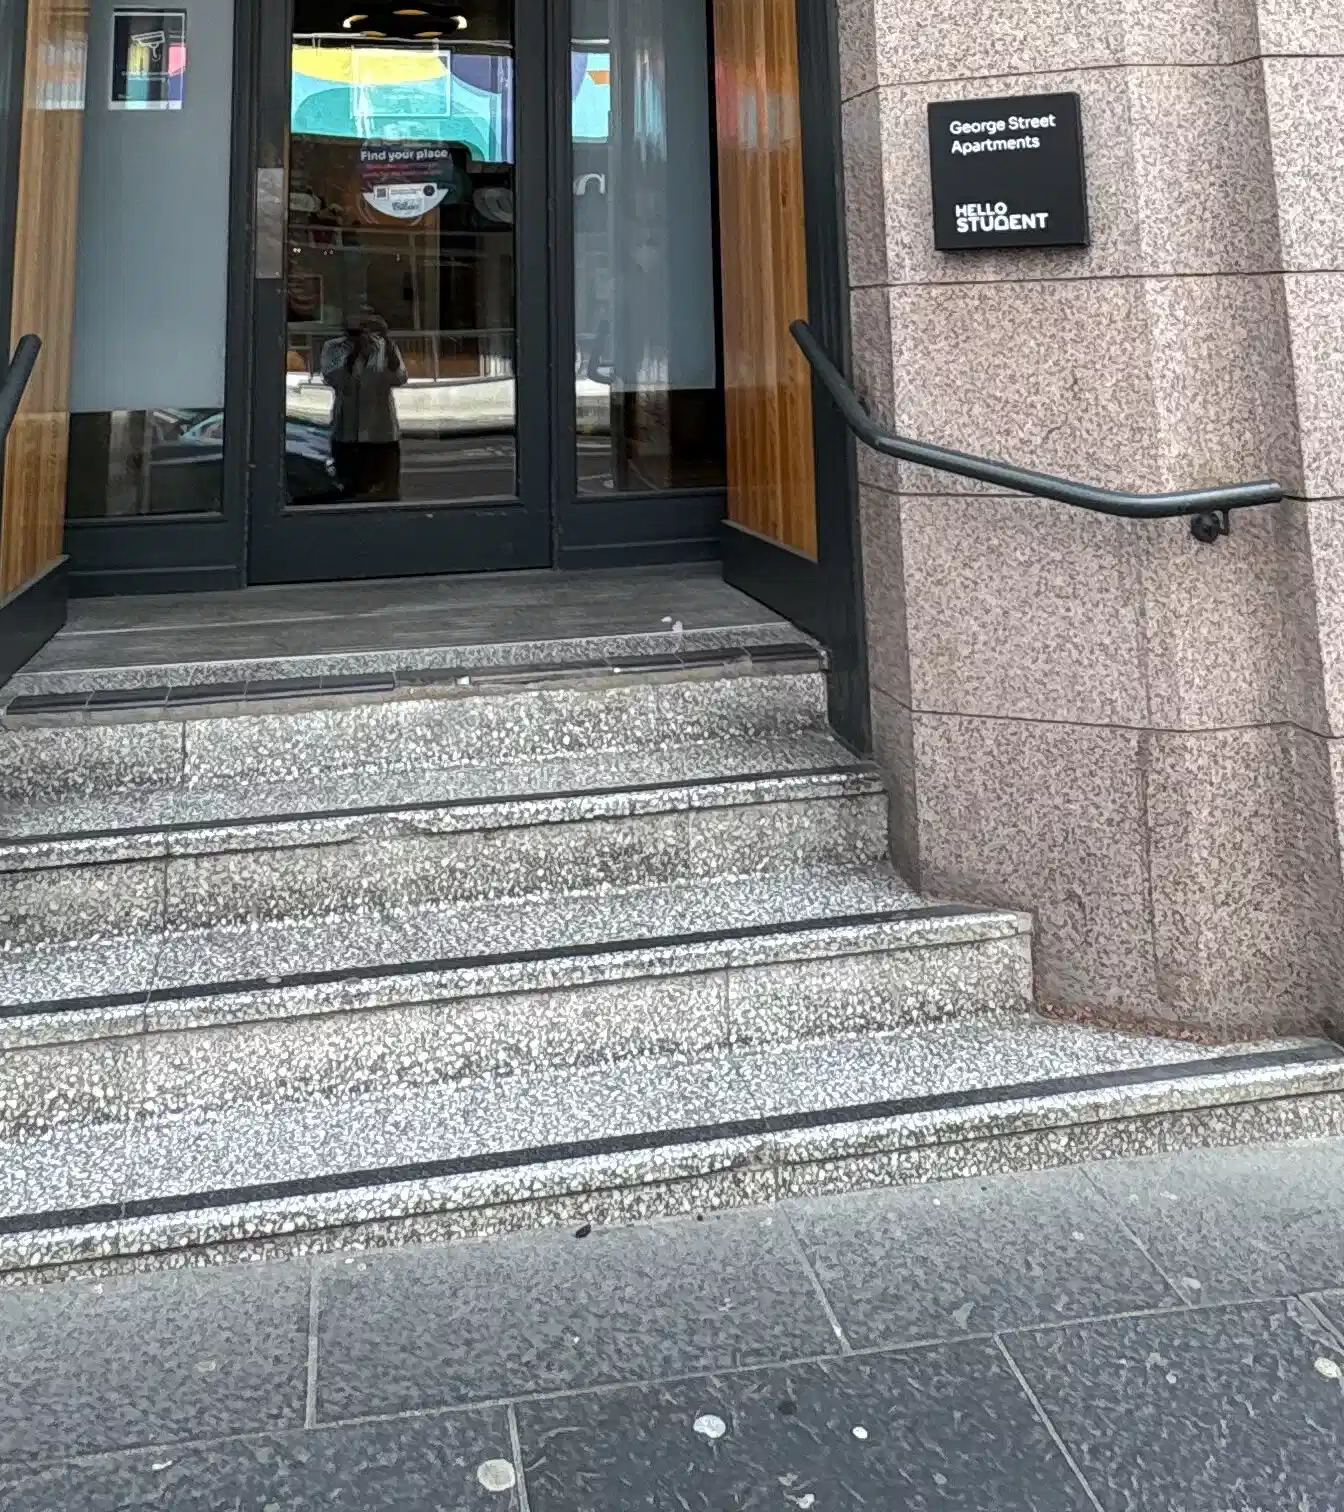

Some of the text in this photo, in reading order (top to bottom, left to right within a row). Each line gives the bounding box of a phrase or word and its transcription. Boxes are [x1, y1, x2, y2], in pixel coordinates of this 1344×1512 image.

[949, 114, 1056, 135] George Street
[360, 148, 448, 162] Find your place
[951, 135, 1040, 156] Apartments
[955, 201, 1008, 217] HELLO
[956, 212, 1049, 233] STUDENT
